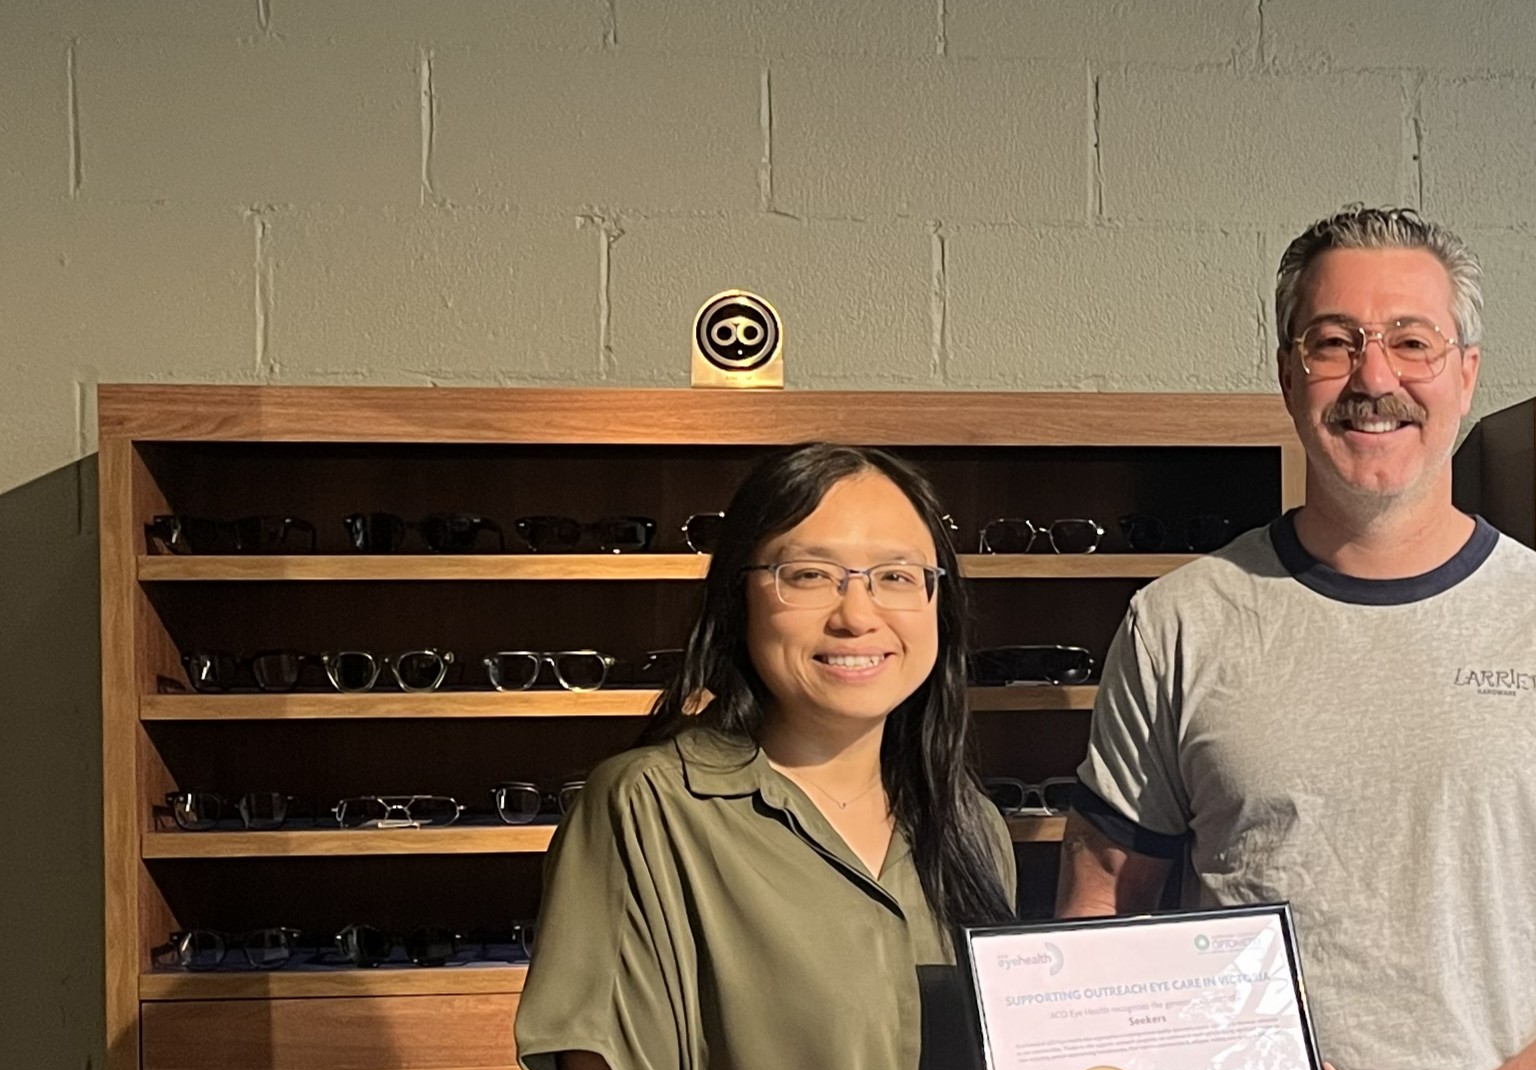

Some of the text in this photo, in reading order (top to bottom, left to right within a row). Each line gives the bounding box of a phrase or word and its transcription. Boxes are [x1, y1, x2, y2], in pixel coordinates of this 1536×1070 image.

[997, 952, 1052, 970] eyehealth
[1005, 989, 1081, 1007] SUPPORTING
[1083, 982, 1147, 999] OUTREACH
[1149, 980, 1170, 993] EYE
[1172, 977, 1202, 991] CARE
[1204, 978, 1217, 987] IN
[1128, 1015, 1167, 1026] Seekers
